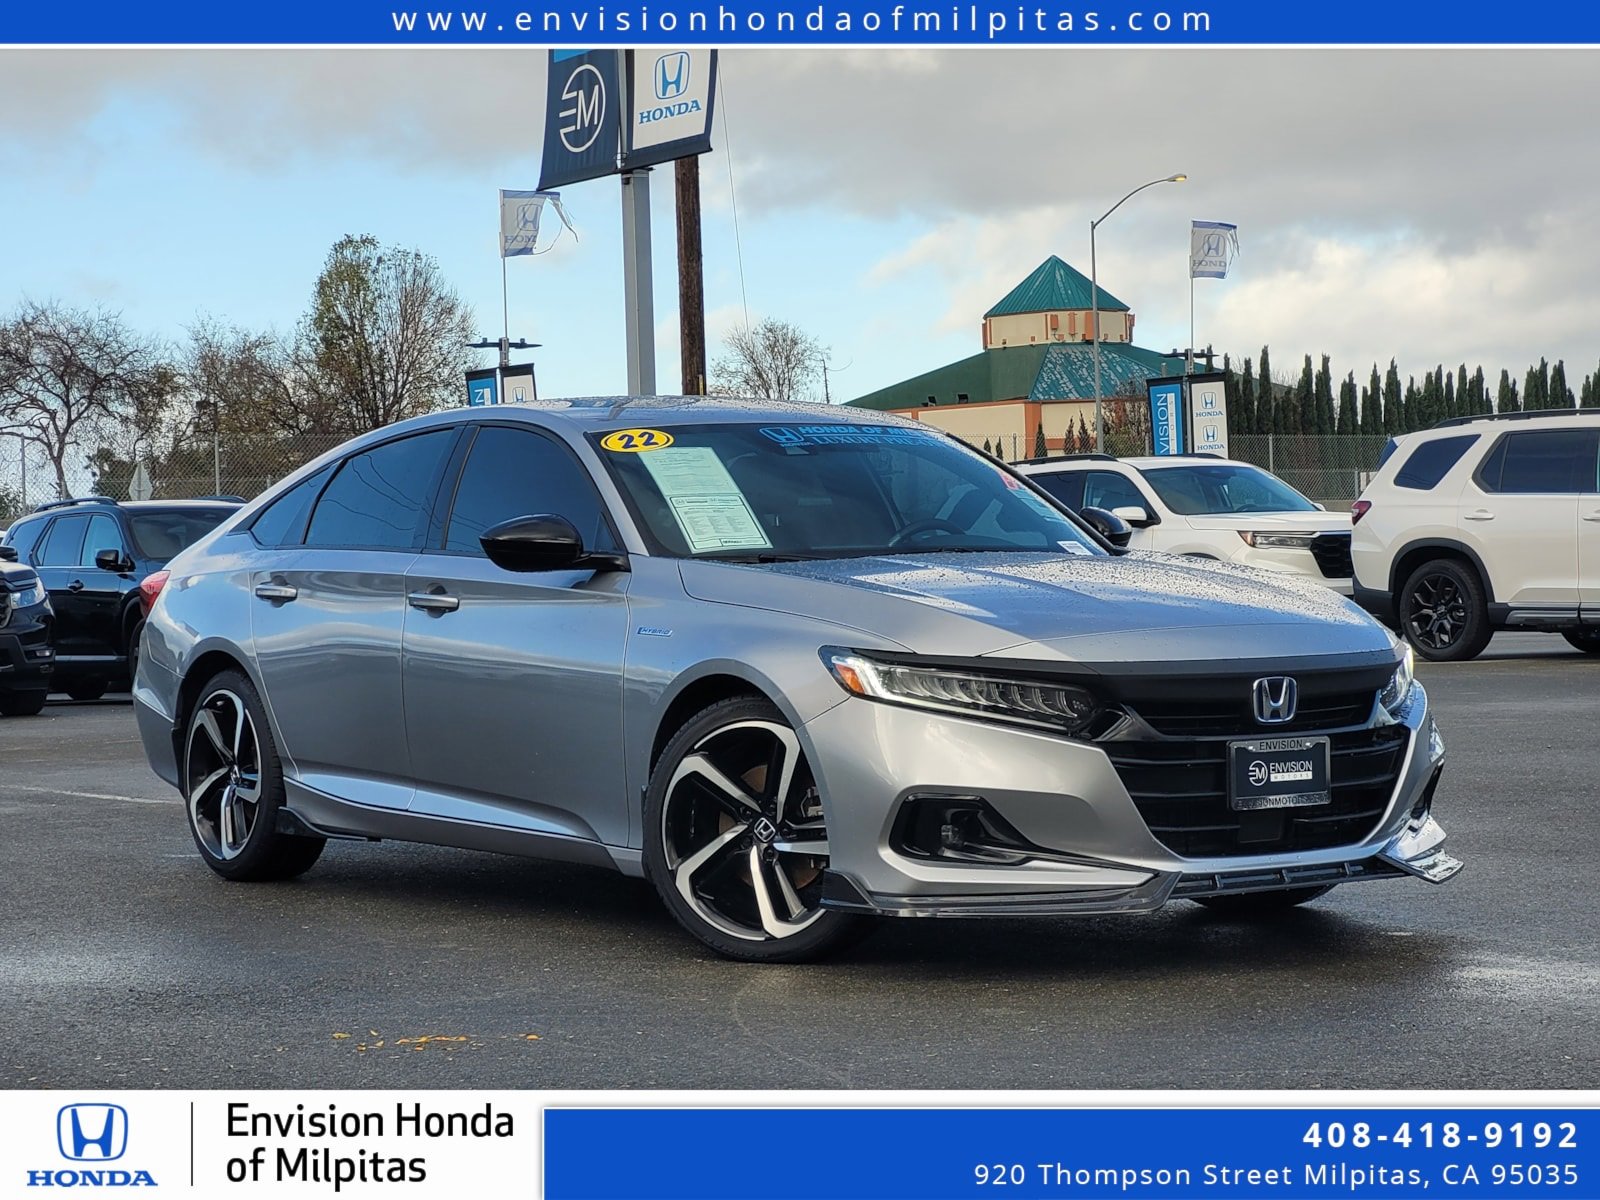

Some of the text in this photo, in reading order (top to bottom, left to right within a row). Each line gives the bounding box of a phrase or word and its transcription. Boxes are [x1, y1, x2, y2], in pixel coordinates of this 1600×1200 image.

[639, 99, 701, 124] HONDA
[1195, 410, 1224, 418] HONDA
[798, 426, 860, 435] HONDA
[862, 427, 881, 435] OF
[617, 431, 659, 449] 22
[1260, 740, 1303, 751] ENVISION
[1269, 760, 1313, 774] ENVISION
